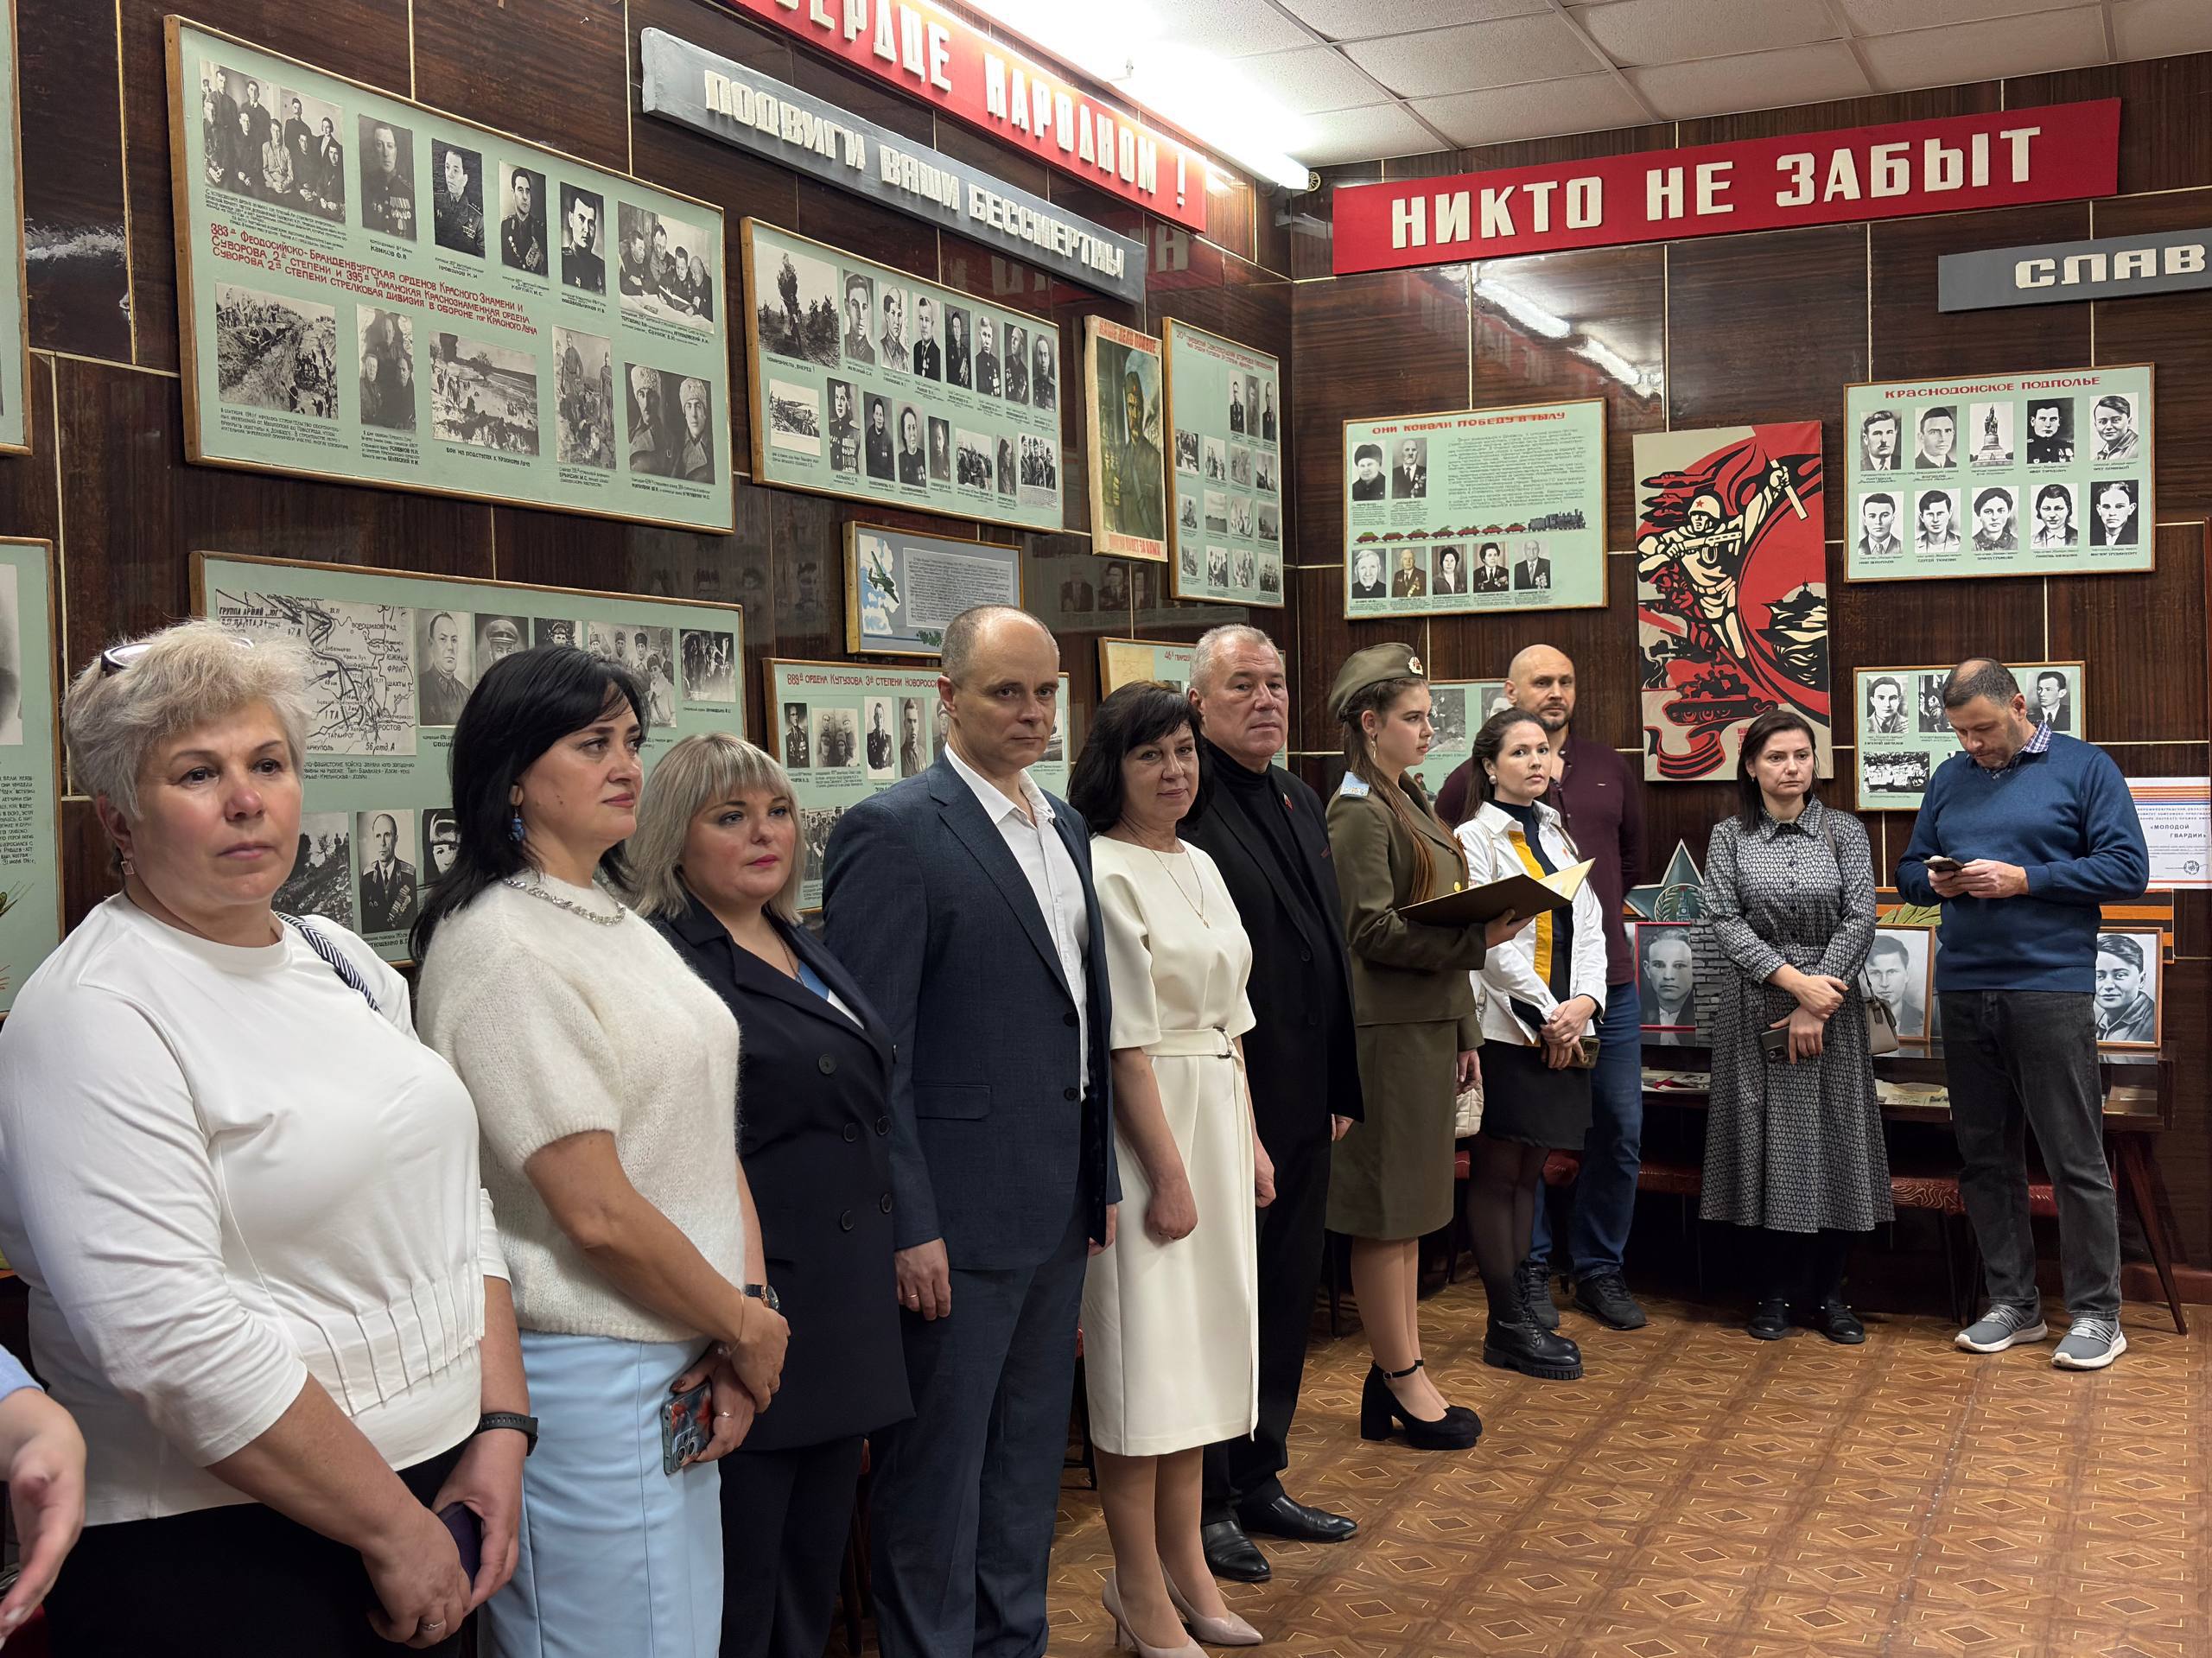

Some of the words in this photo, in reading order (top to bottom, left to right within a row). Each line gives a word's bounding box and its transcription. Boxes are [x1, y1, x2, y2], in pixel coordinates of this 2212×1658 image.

[774, 0, 952, 92] РДЦЕ
[983, 52, 1158, 194] НАРОДНОМ
[704, 70, 866, 170] ПОДВИГИ
[880, 144, 960, 211] ВАШИ
[968, 183, 1125, 280] БЕССМЕРТНЫ
[1391, 175, 1602, 249] НИКТО
[1646, 161, 1733, 221] НЕ
[1776, 126, 2042, 207] ЗАБЫТ
[212, 236, 267, 258] СУВОРОВА
[290, 258, 332, 276] СТЕПЕНИ
[375, 278, 421, 298] ТАМАНСКАЯ
[503, 311, 531, 324] ОРДЕНА
[213, 247, 264, 268] СУВОРОВА
[285, 266, 327, 283] СТЕПЕНИ
[330, 278, 383, 297] СТРЕЛКОВАЯ
[386, 292, 424, 308] ДИВИЗИЯ
[429, 302, 435, 310] В
[437, 303, 474, 320] ОБОРОНЕ
[2015, 244, 2206, 289] СЛАВ
[398, 274, 436, 291] ОРДЕНОВ
[440, 282, 479, 302] КРАСНОГО
[480, 291, 515, 309] ЗНАМЕНИ
[1885, 382, 2015, 400] КРАСНОДОНСКОЕ
[2020, 376, 2101, 391] ПОДПОЛЬЕ
[1372, 425, 1397, 435] ОНИ
[1403, 422, 1452, 432] КОВАЛИ
[219, 607, 241, 616] ГРУППА
[804, 675, 828, 684] ОРДЕНА
[830, 673, 863, 686] КУТУЗОВА
[875, 677, 903, 688] СТЕПЕНИ
